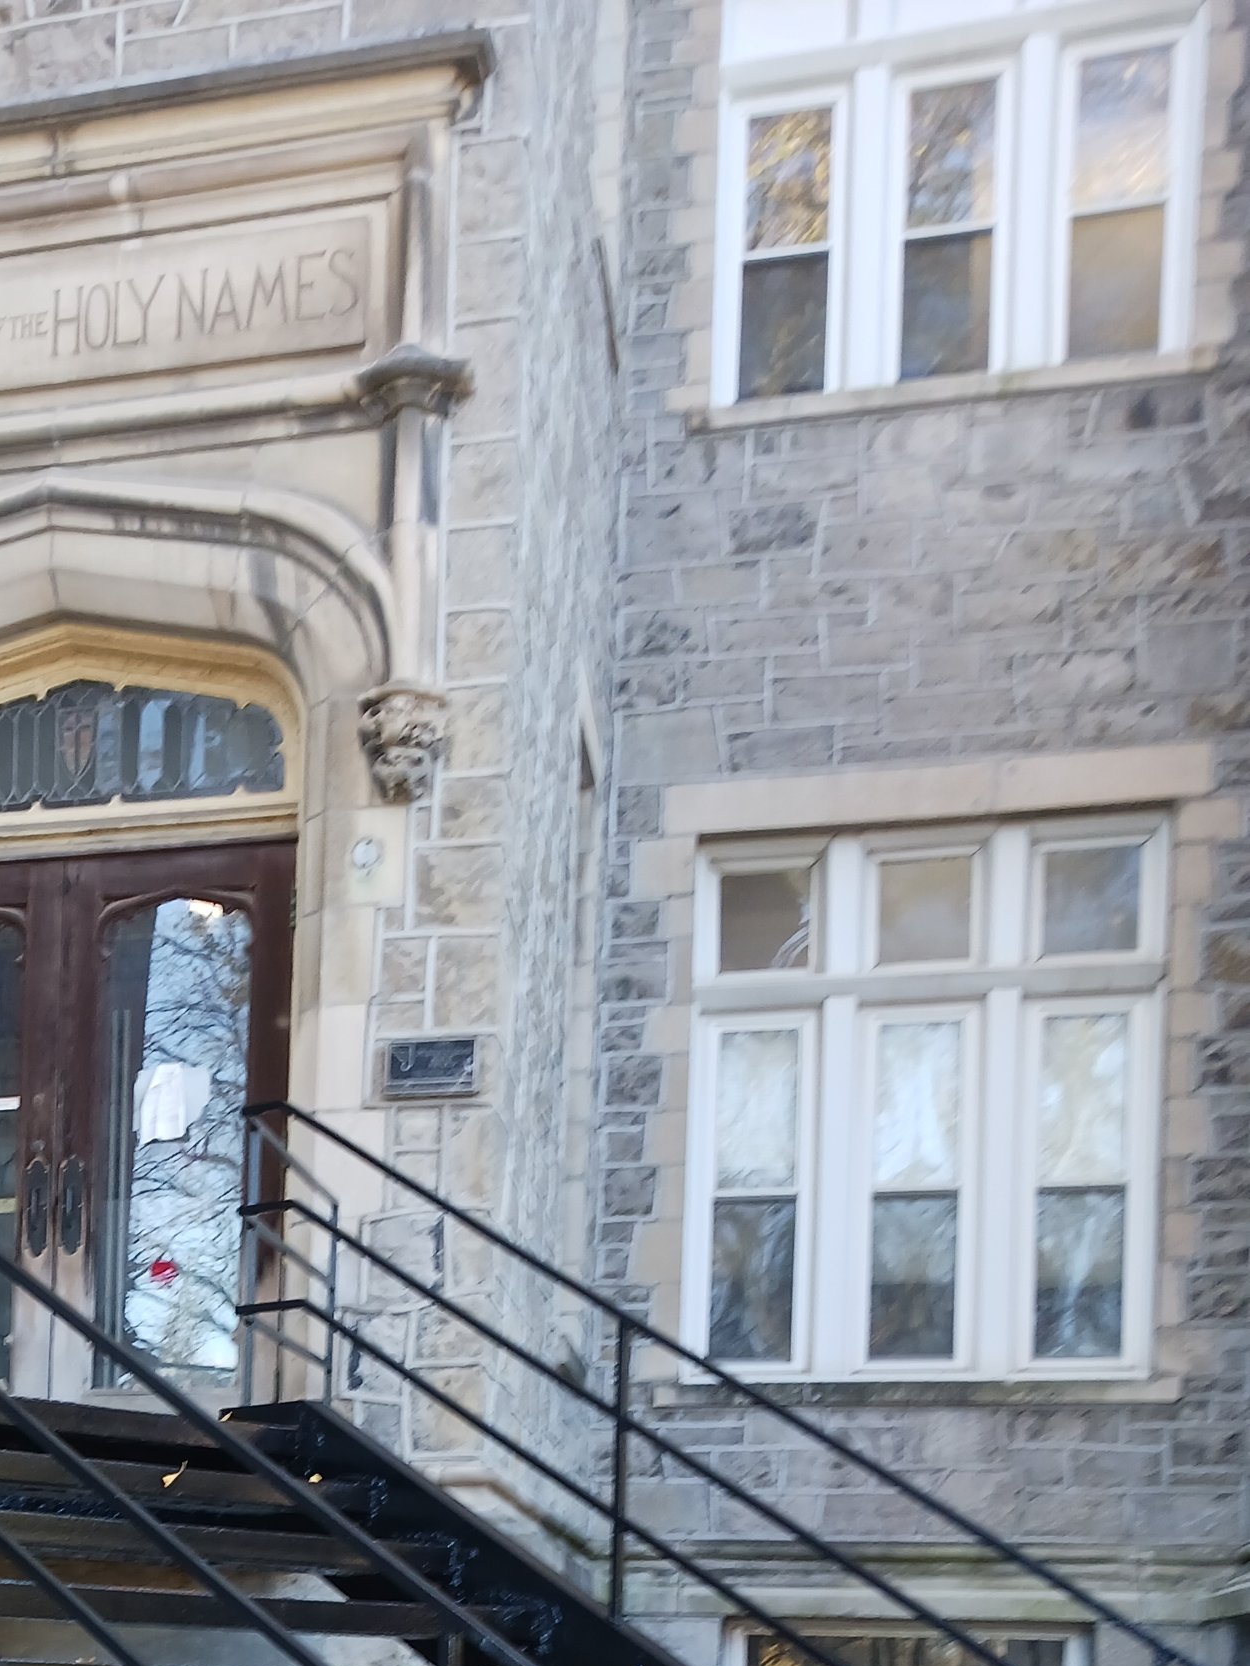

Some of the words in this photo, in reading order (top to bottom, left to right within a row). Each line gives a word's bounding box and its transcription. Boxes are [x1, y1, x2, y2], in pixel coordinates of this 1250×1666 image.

[9, 310, 50, 340] THE
[52, 273, 166, 357] HOLY
[174, 249, 359, 342] NAMES
